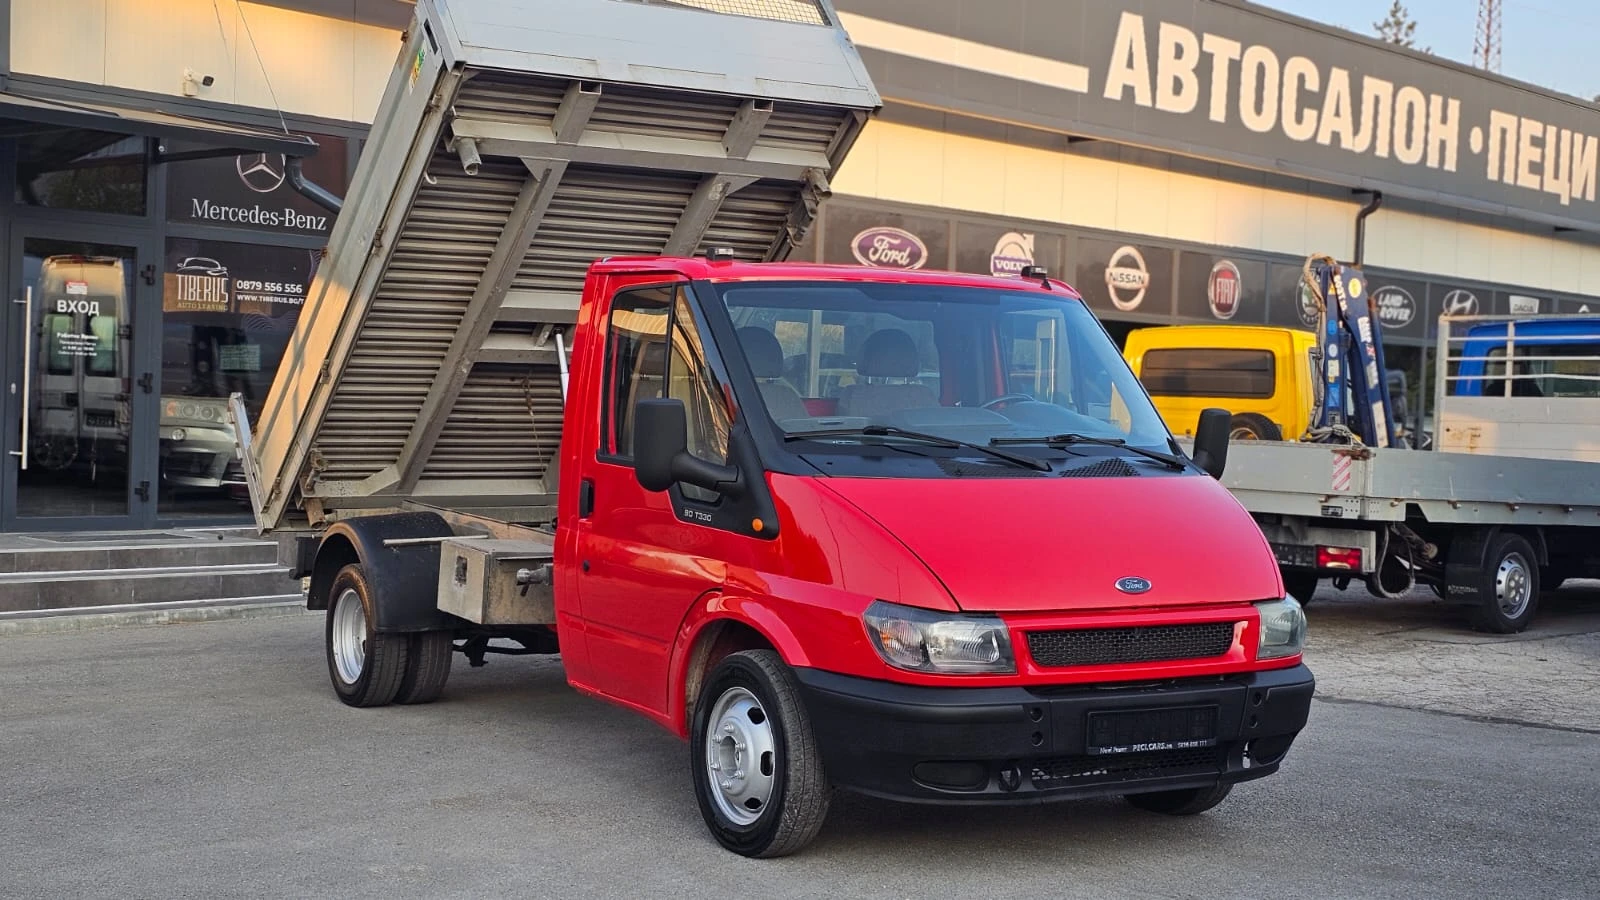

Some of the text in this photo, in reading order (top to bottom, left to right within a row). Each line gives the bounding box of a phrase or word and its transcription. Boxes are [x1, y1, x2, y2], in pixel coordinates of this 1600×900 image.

[1103, 11, 1598, 206] АВТОСАЛОН ПЕЦИ
[191, 198, 327, 231] Mercedes-Benz
[868, 235, 911, 266] Ford
[994, 259, 1031, 271] VOLV
[236, 279, 303, 294] 0879 556 556
[1109, 271, 1145, 286] NISSAN
[175, 274, 229, 303] TIBERUS
[1215, 278, 1235, 304] FIAT
[56, 299, 100, 317] ВХОД
[1378, 293, 1403, 307] LAND
[1379, 306, 1411, 321] ROVER
[1125, 579, 1144, 589] Ford
